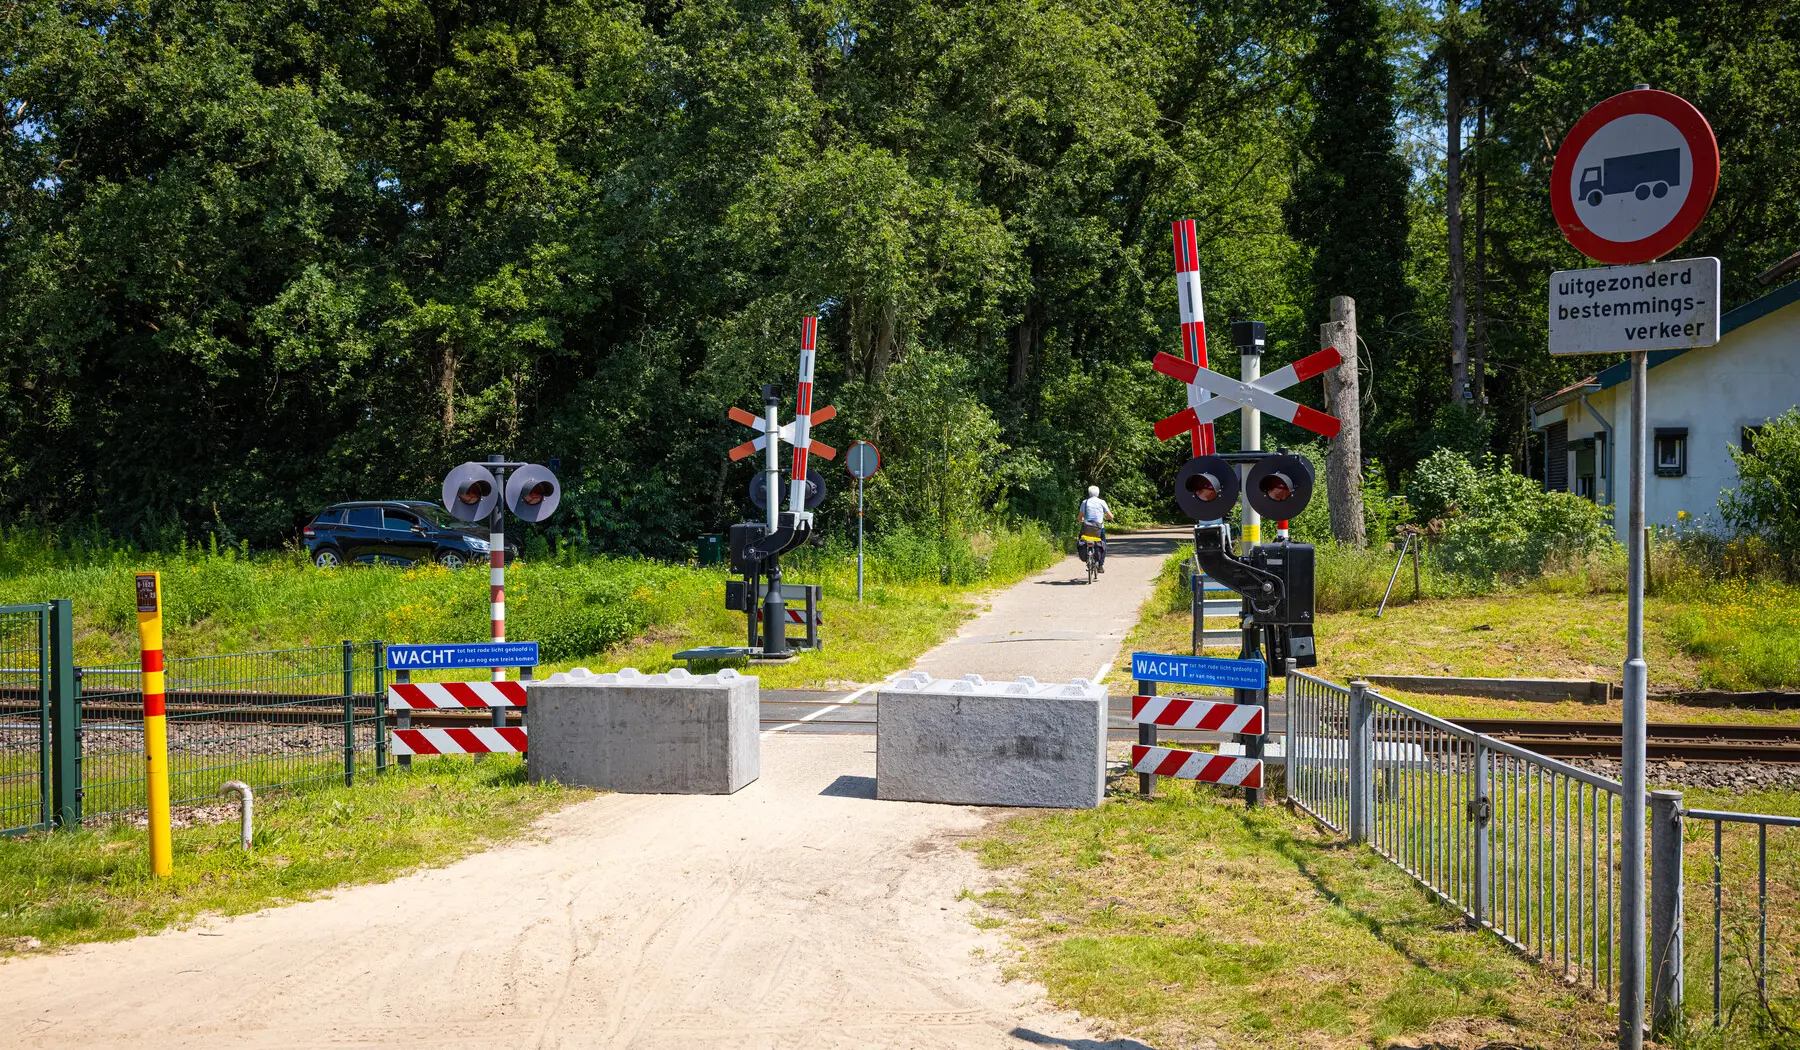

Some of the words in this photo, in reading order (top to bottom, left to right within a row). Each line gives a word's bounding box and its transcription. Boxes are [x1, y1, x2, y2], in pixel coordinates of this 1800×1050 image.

[1558, 267, 1692, 299] uitgezonderd
[1558, 296, 1706, 321] bestemmings-
[1624, 321, 1706, 341] verkeer
[391, 649, 455, 665] WACHT
[504, 646, 528, 654] gedoofd
[1136, 659, 1189, 678] WACHT
